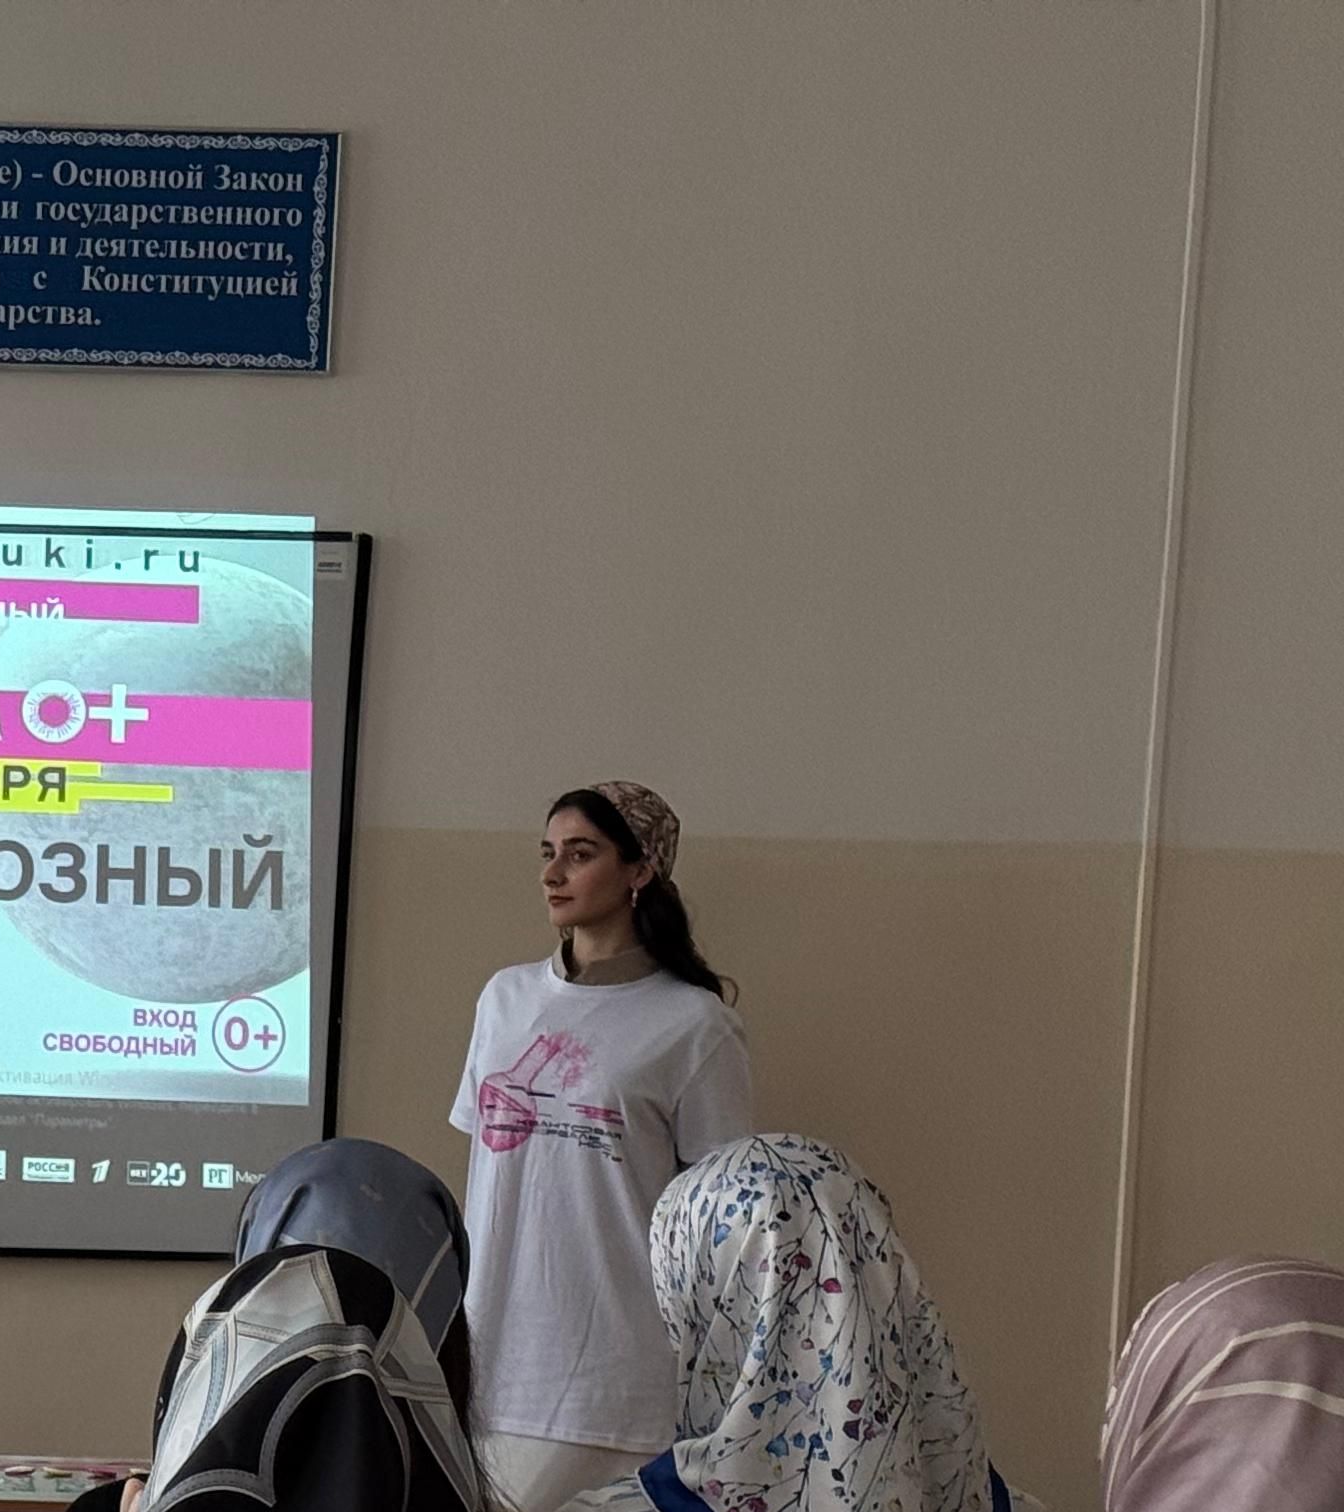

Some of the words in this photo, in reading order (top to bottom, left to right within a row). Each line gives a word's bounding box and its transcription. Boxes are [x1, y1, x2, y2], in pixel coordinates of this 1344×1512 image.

[51, 158, 204, 191] Основной
[213, 163, 304, 193] Закон
[0, 199, 20, 221] и
[35, 200, 304, 231] государственного
[48, 235, 68, 257] и
[74, 236, 295, 267] деятельности,
[32, 269, 49, 291] с
[80, 264, 299, 302] Конституцией
[132, 1007, 198, 1032] ВХОД
[223, 1015, 279, 1050] 0+
[42, 1032, 198, 1058] СВОБОДНЫЙ
